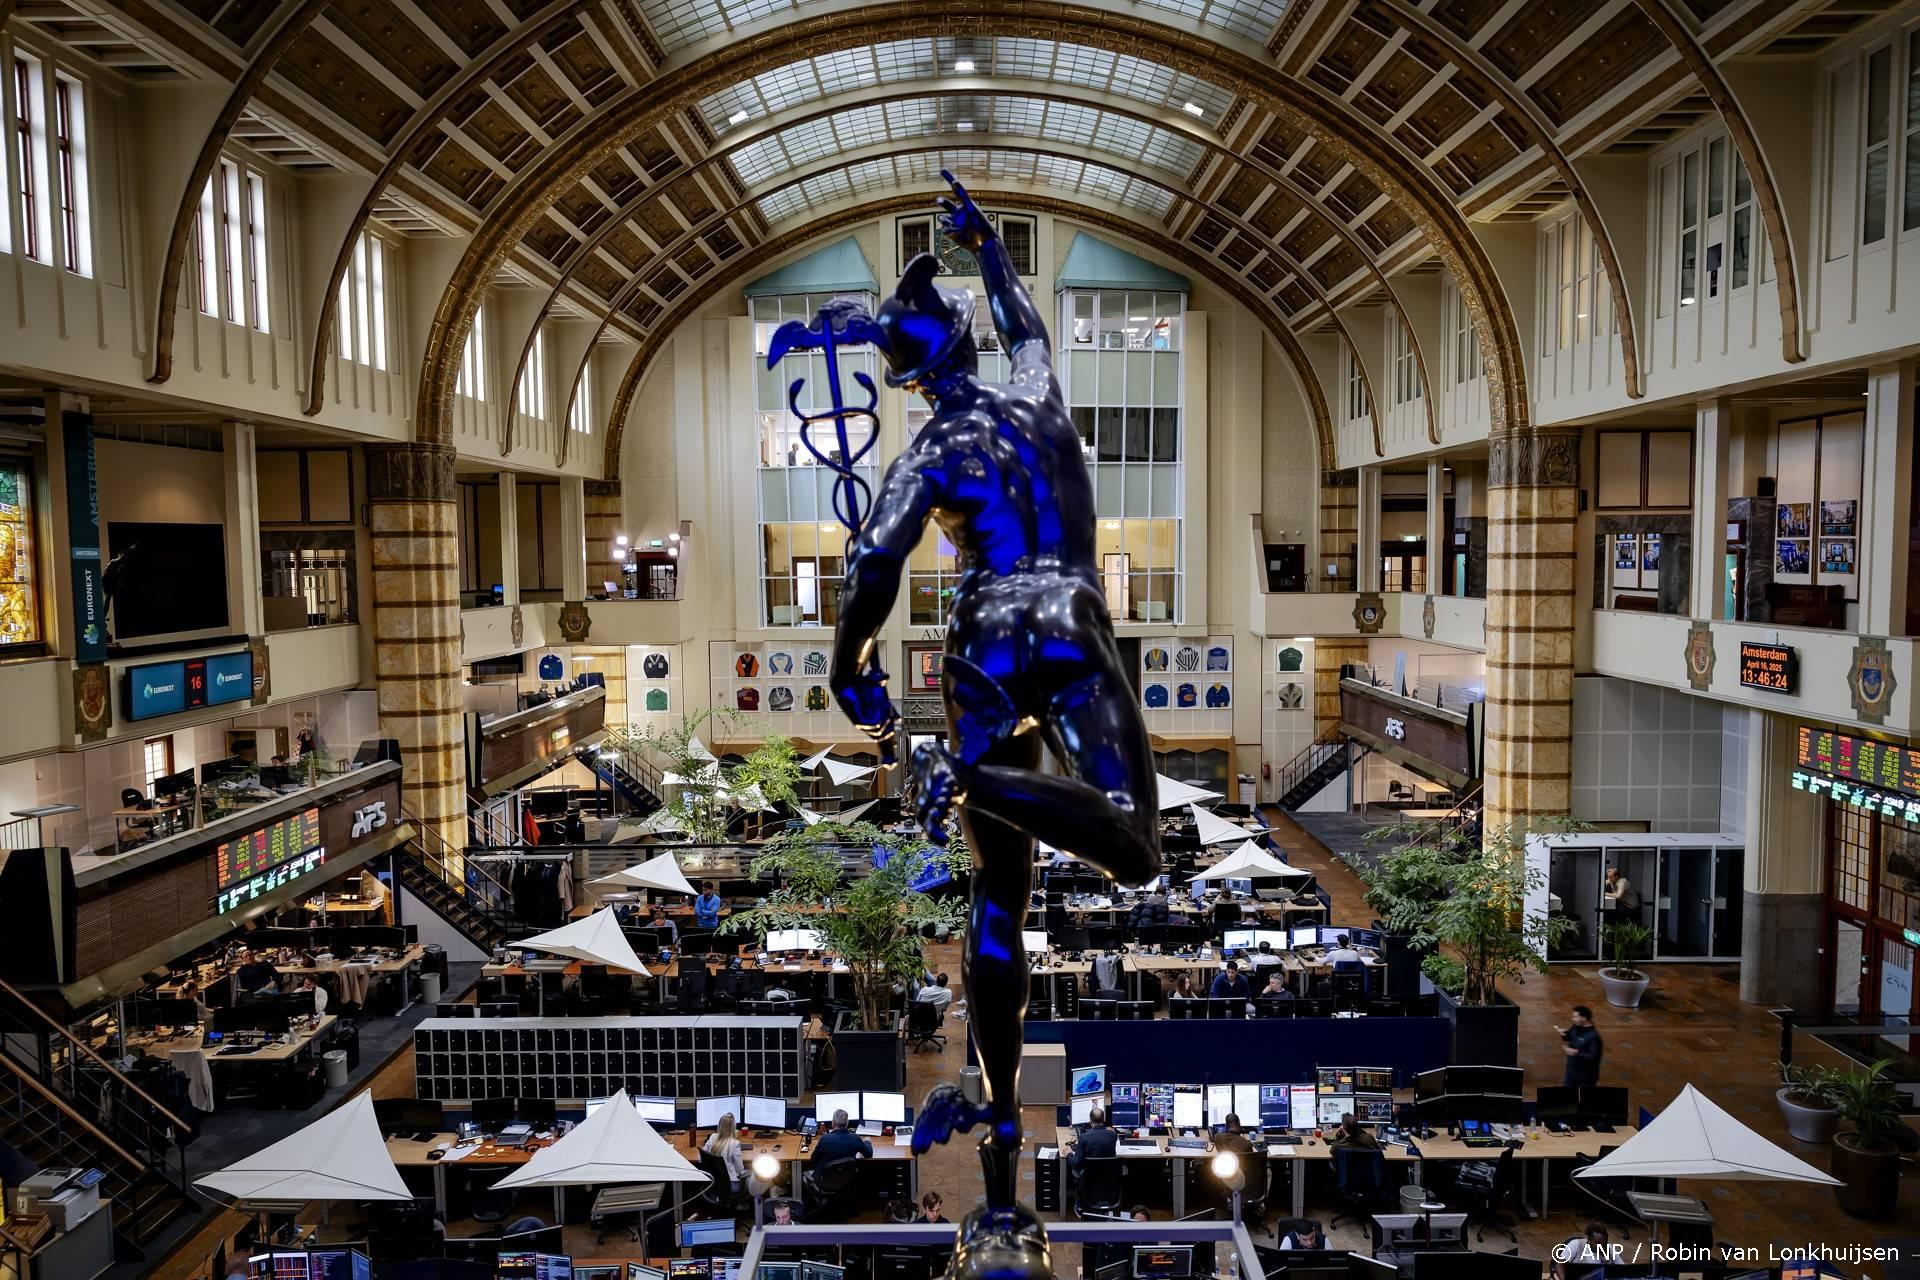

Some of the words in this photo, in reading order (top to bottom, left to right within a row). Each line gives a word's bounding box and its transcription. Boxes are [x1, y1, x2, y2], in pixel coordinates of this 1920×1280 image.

[86, 424, 99, 527] AMSTERDAM
[85, 568, 94, 620] EURONEXT
[922, 628, 946, 640] AM
[1742, 645, 1787, 661] Amsterdam
[1747, 660, 1760, 669] April
[1769, 663, 1782, 672] 2025
[191, 676, 202, 690] 16
[224, 673, 243, 683] EURONEXT
[1742, 668, 1787, 688] 13:46:24
[153, 684, 175, 694] EURONEXT
